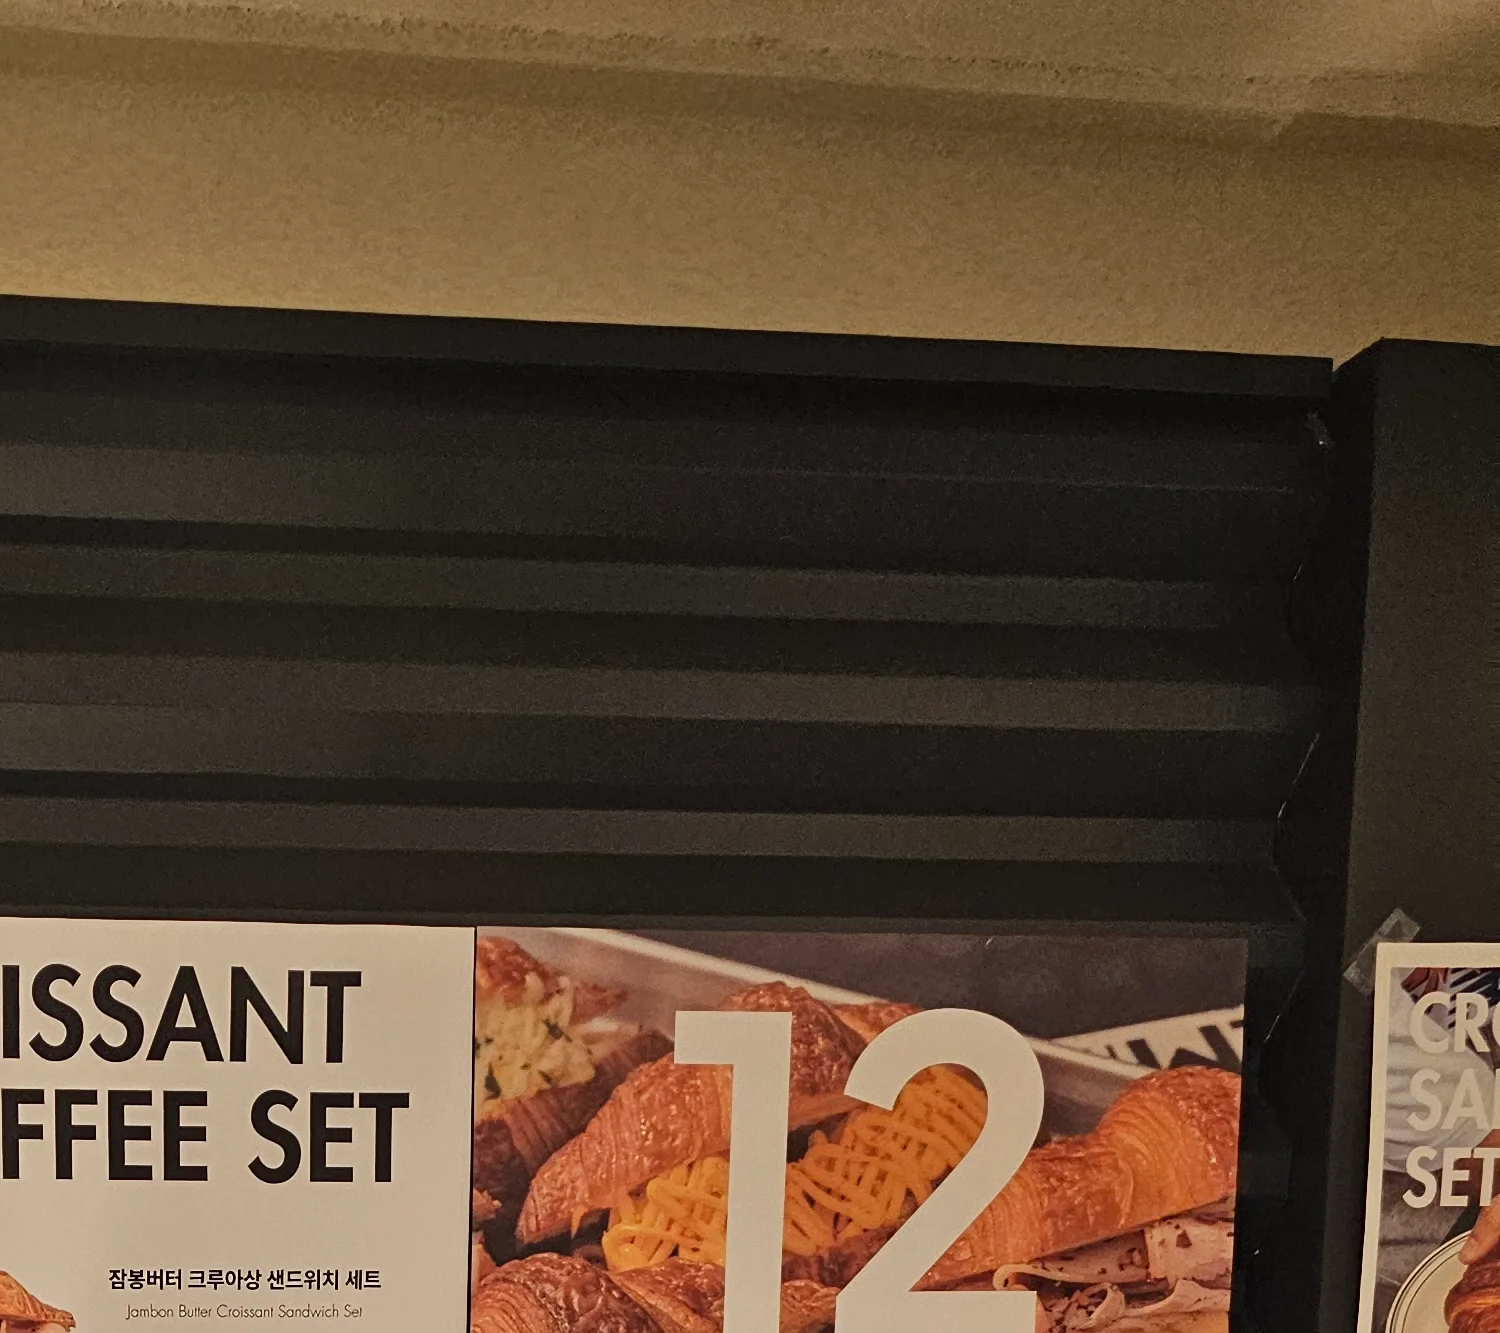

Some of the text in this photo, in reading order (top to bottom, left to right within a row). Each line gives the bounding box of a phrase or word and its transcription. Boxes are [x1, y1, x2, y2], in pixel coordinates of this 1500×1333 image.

[1409, 991, 1500, 1054] CR
[1406, 1068, 1500, 1133] SA
[247, 1089, 411, 1185] SET
[1402, 1145, 1500, 1209] SET
[108, 1268, 381, 1291] 잠봉버터 크루아상 샌드위치 세트
[126, 1304, 363, 1320] Jambon Butter Croissant Sandwich Set
